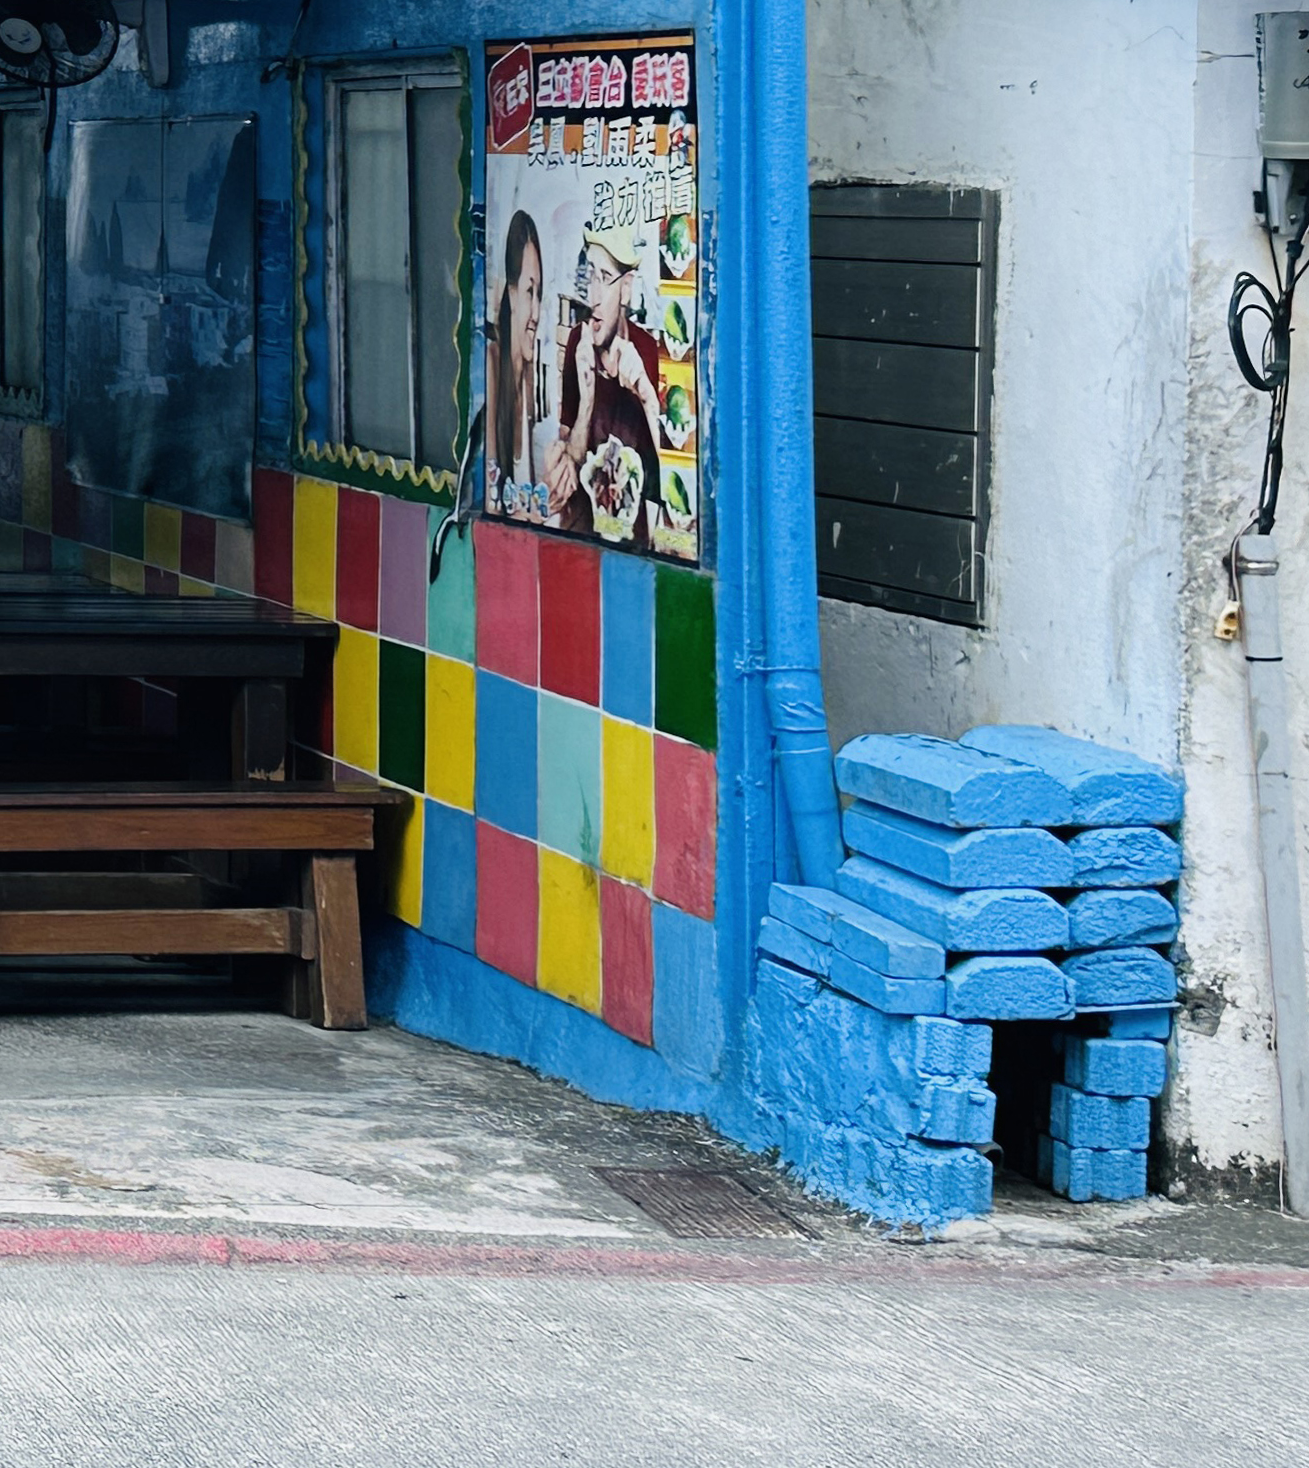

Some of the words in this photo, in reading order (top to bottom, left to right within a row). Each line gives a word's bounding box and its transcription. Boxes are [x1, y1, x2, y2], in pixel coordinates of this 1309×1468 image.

[536, 56, 627, 109] 三立都會台
